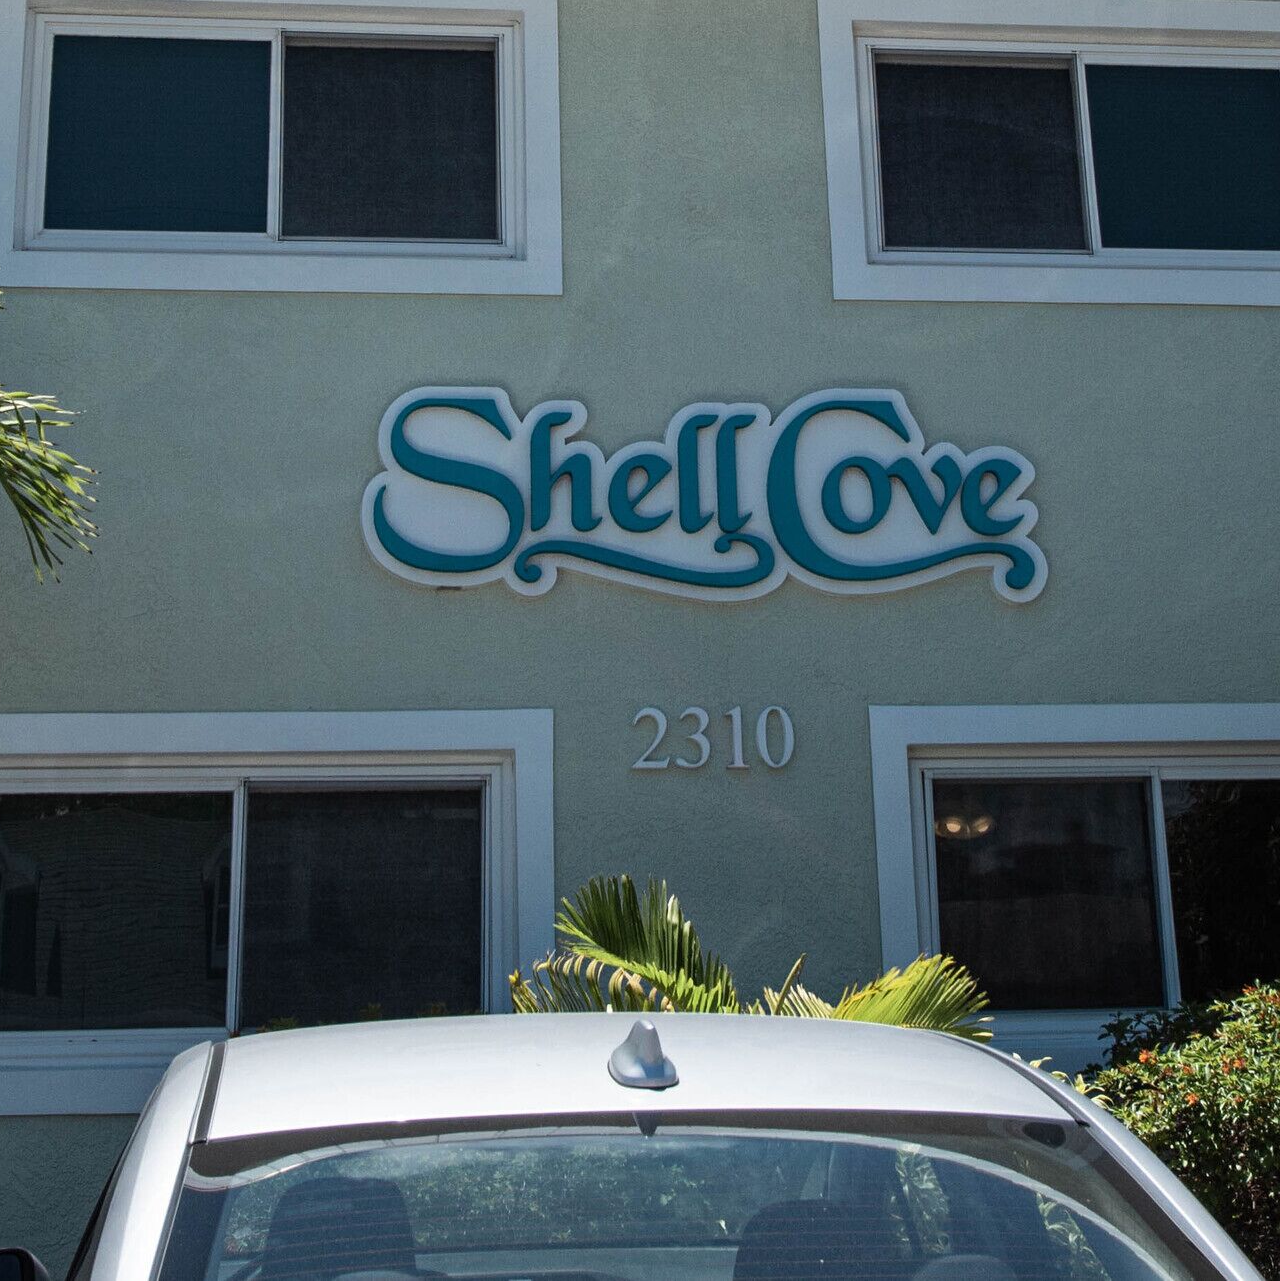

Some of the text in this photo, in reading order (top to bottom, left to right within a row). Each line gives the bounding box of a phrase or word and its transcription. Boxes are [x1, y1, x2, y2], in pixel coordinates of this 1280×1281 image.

[373, 397, 1036, 590] Shell Cove
[631, 705, 795, 770] 2310
